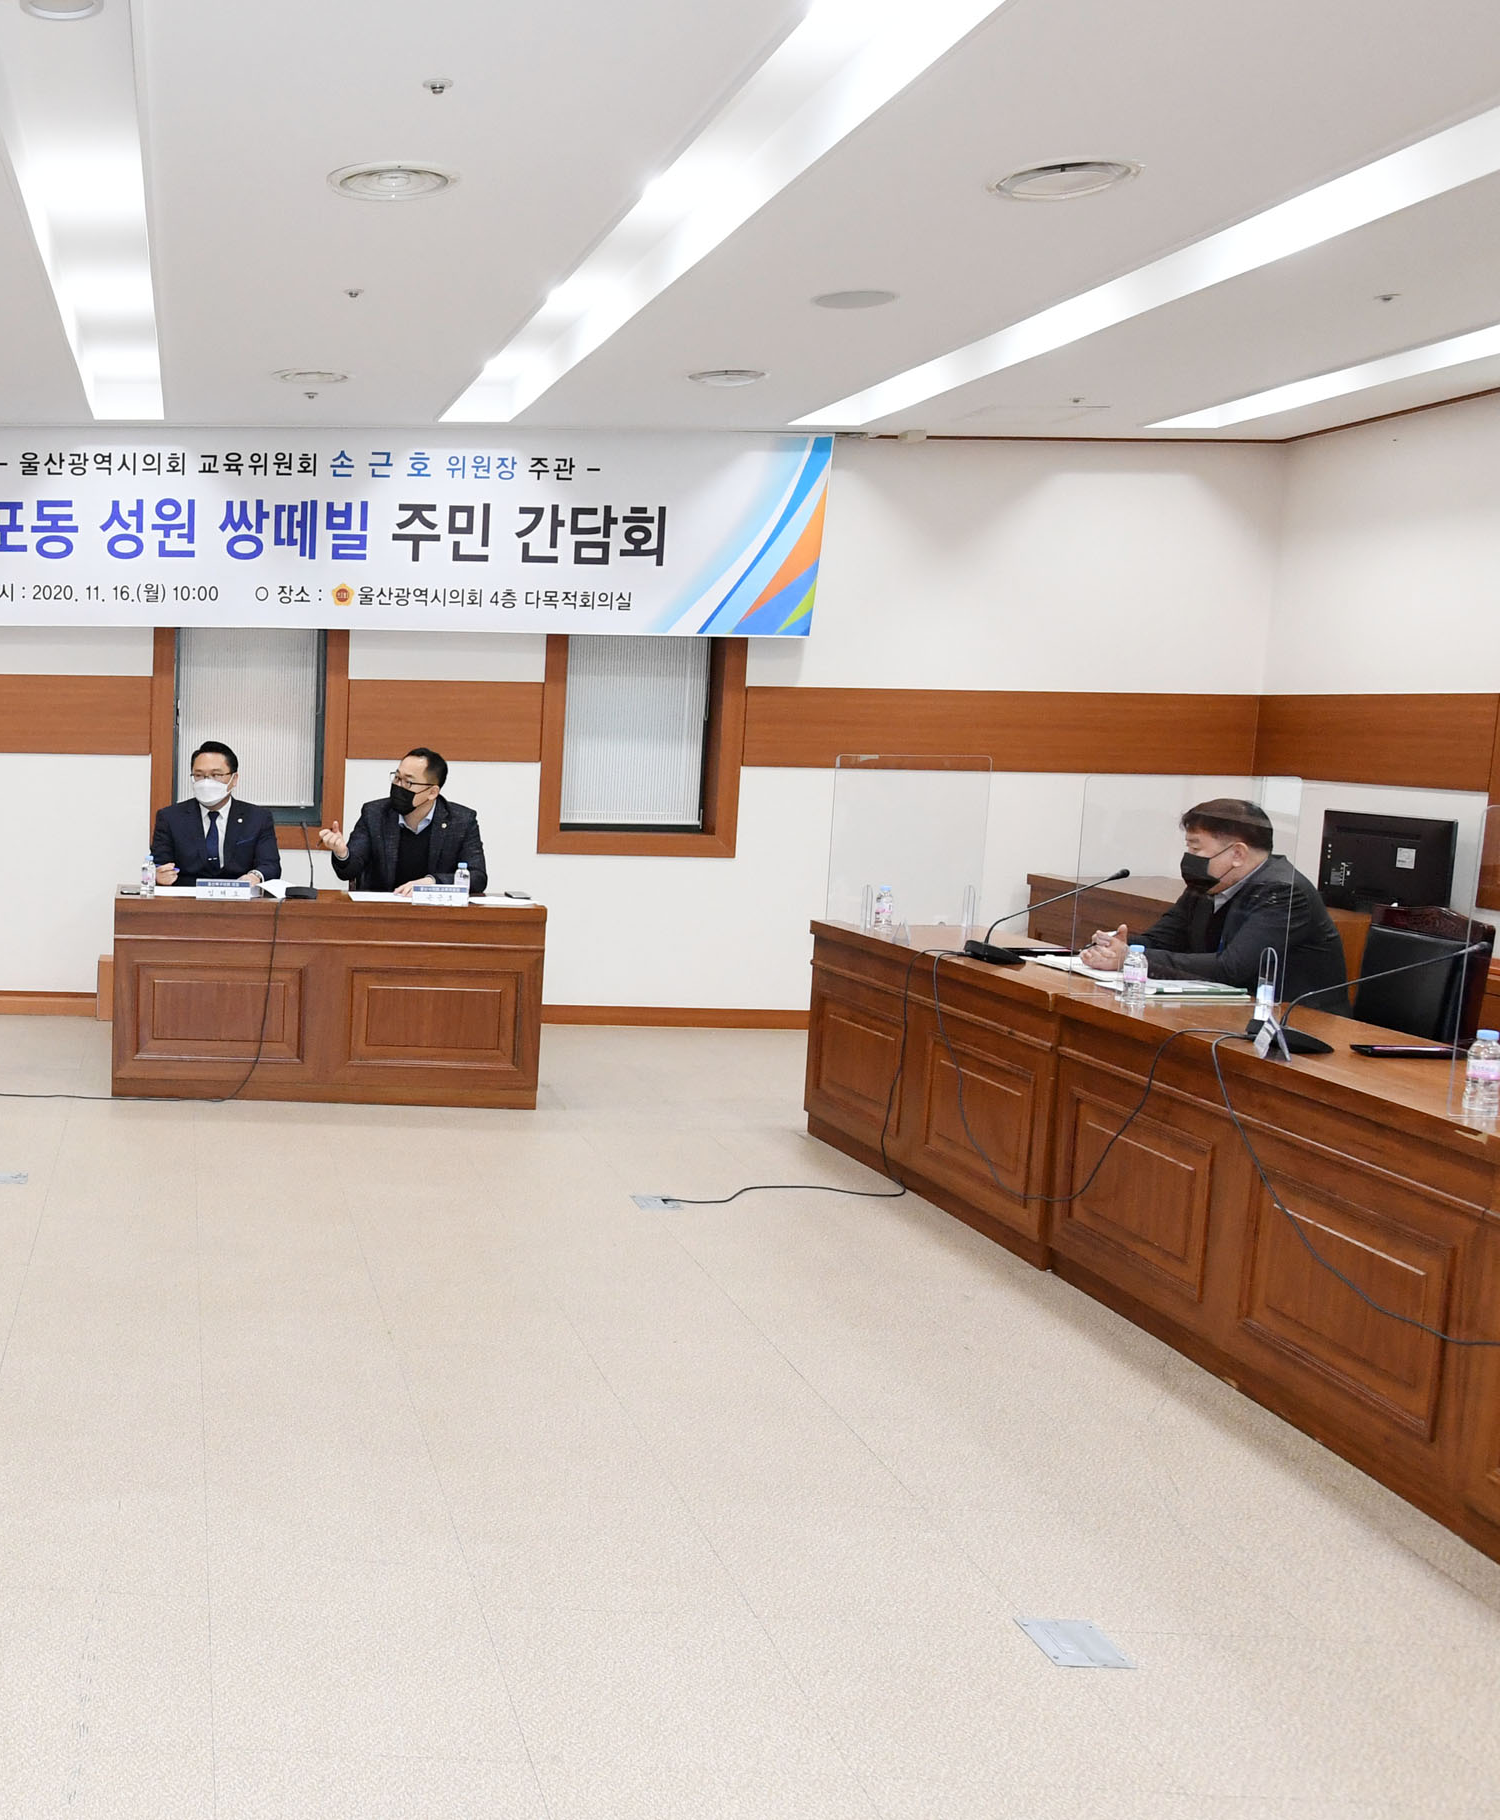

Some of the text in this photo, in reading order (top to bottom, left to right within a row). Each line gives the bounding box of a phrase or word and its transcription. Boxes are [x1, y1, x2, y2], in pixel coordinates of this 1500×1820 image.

[19, 451, 186, 477] 울산광역시의회
[197, 451, 318, 478] 교육위원회
[445, 455, 518, 481] 위원장
[528, 456, 576, 482] 주관
[100, 498, 196, 560] 성원
[219, 498, 369, 561] 쌍떼빌
[392, 502, 491, 562] 주민
[514, 503, 667, 567] 간담회
[32, 584, 79, 603] 2020.
[85, 585, 106, 603] 11.
[172, 585, 219, 602] 10:00
[277, 584, 311, 605] 장소
[357, 585, 483, 608] 울산광역시의회
[489, 588, 518, 609] 4층
[524, 589, 632, 612] 다목적회의실
